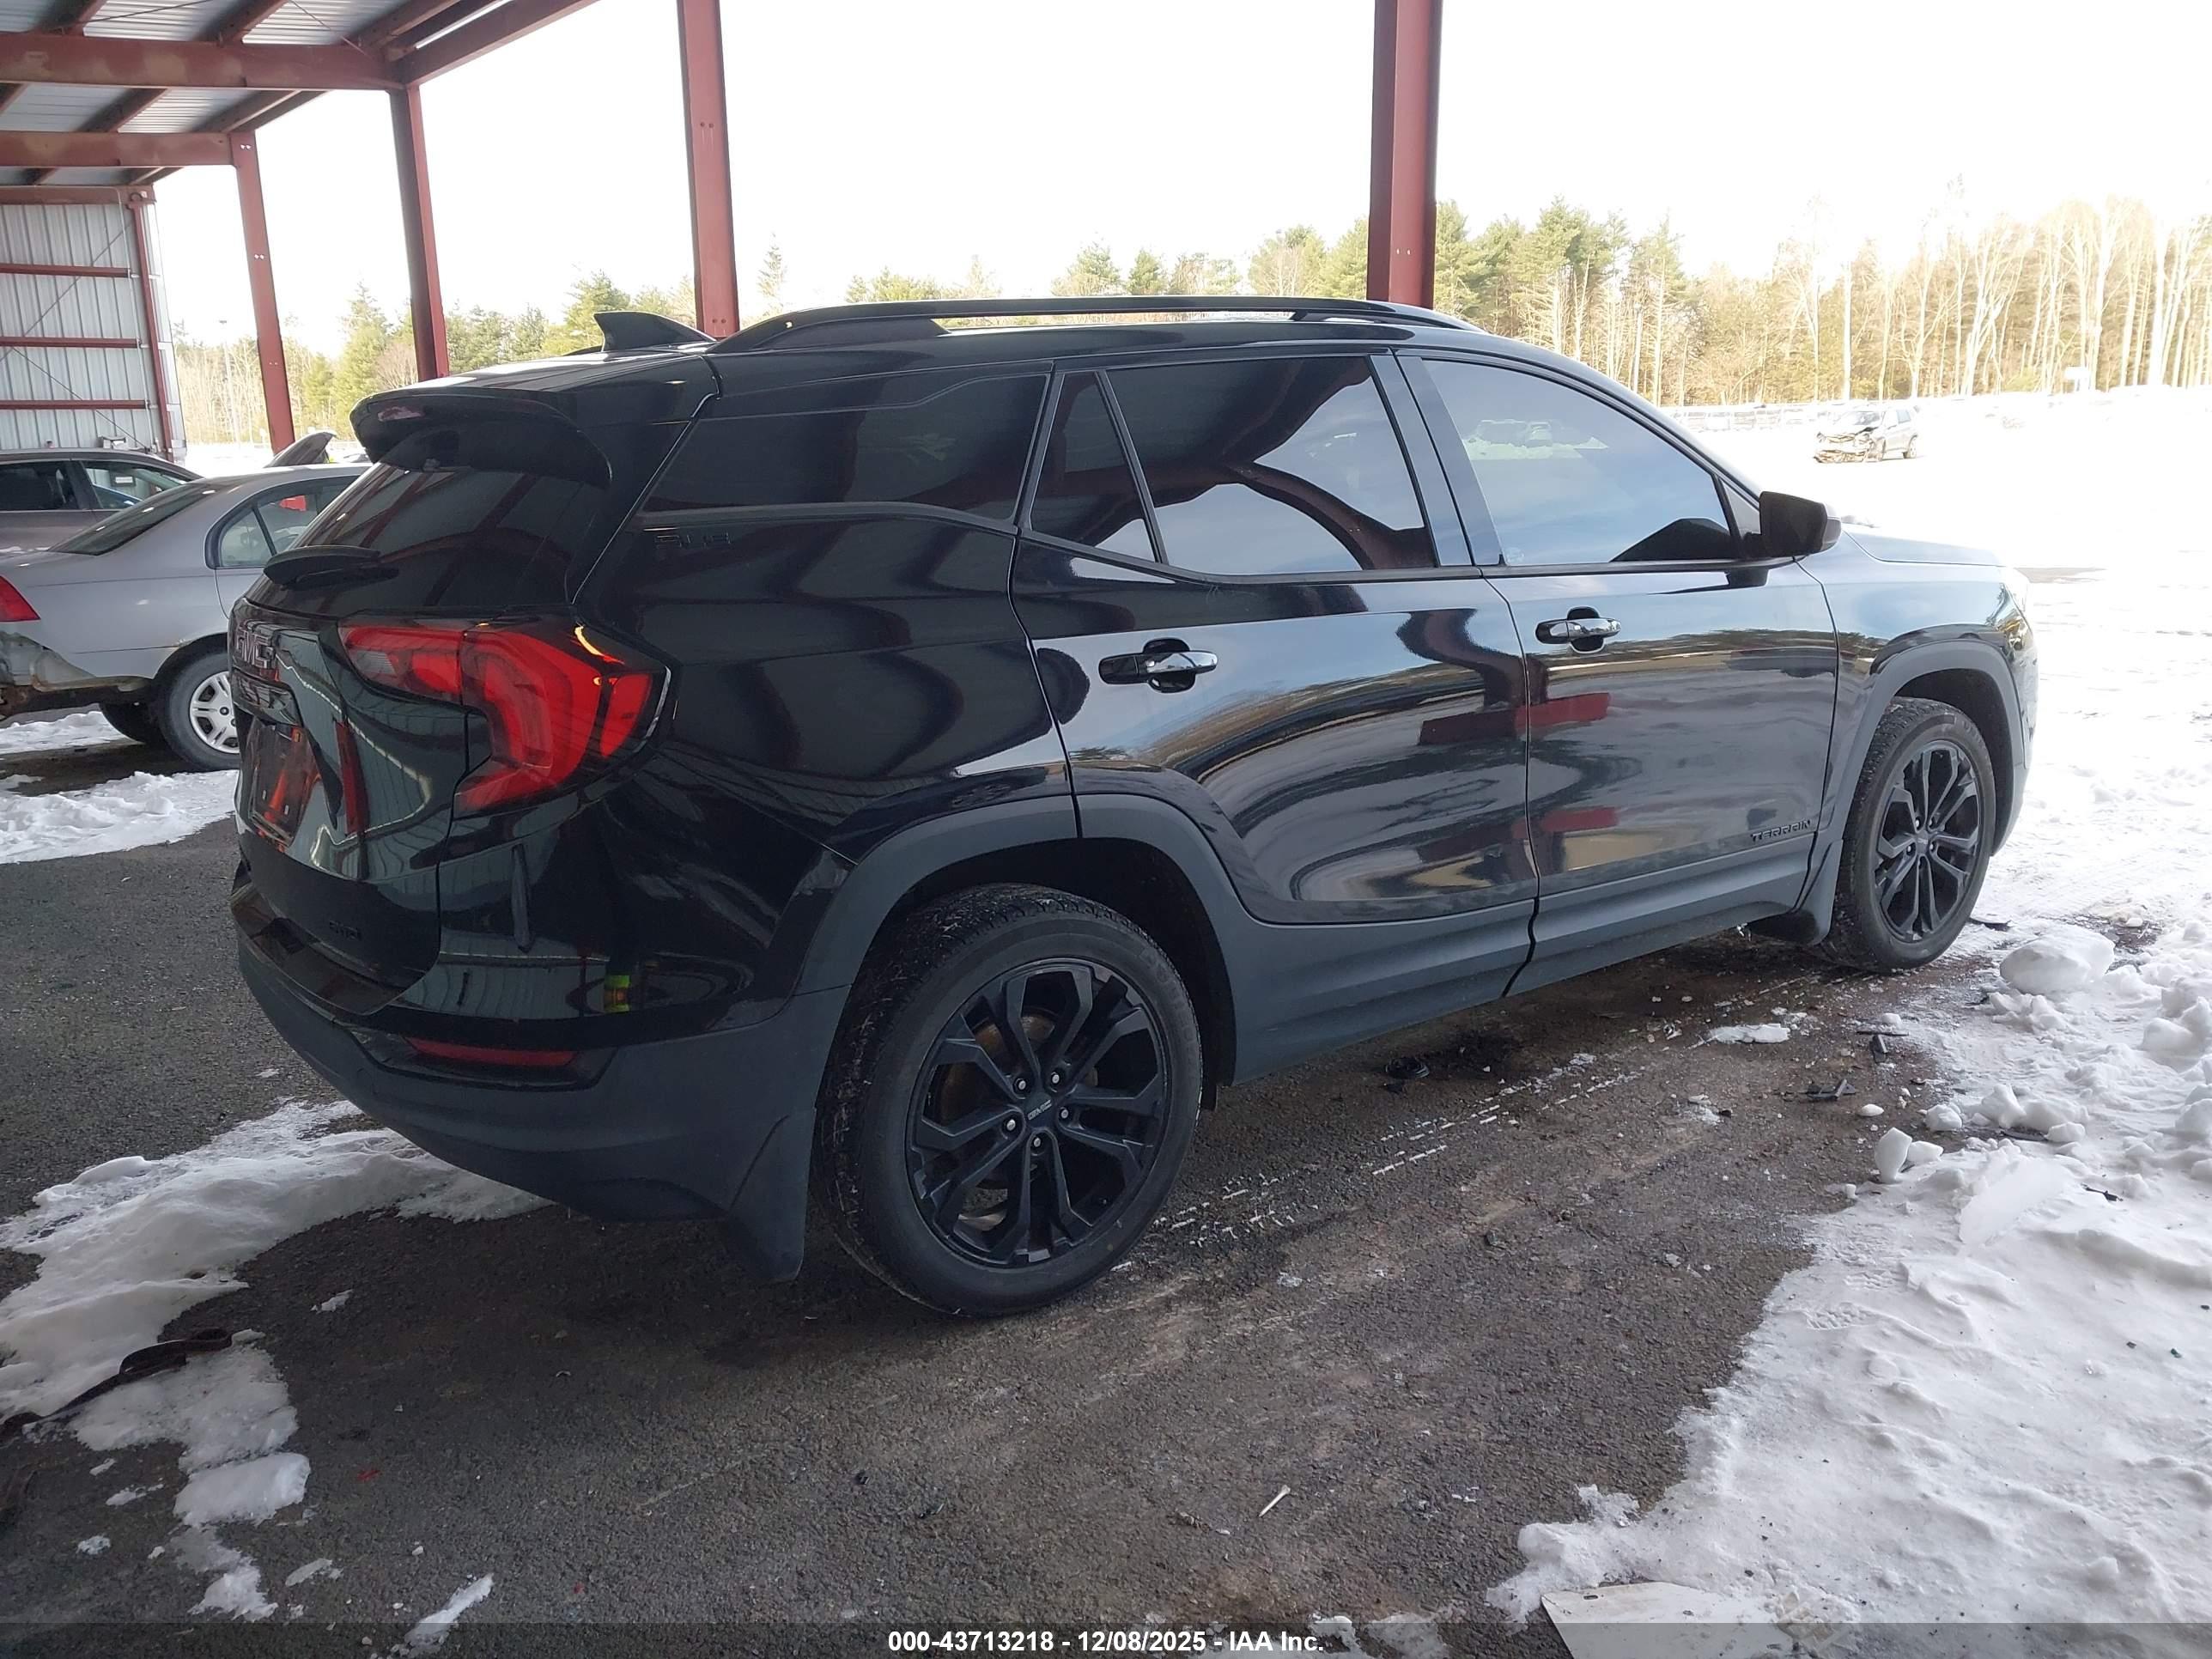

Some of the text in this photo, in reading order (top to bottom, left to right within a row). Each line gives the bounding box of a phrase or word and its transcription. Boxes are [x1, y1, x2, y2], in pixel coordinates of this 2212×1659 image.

[235, 626, 272, 668] GMC
[1750, 819, 1811, 842] TERRAIN
[1028, 1099, 1053, 1121] GMC
